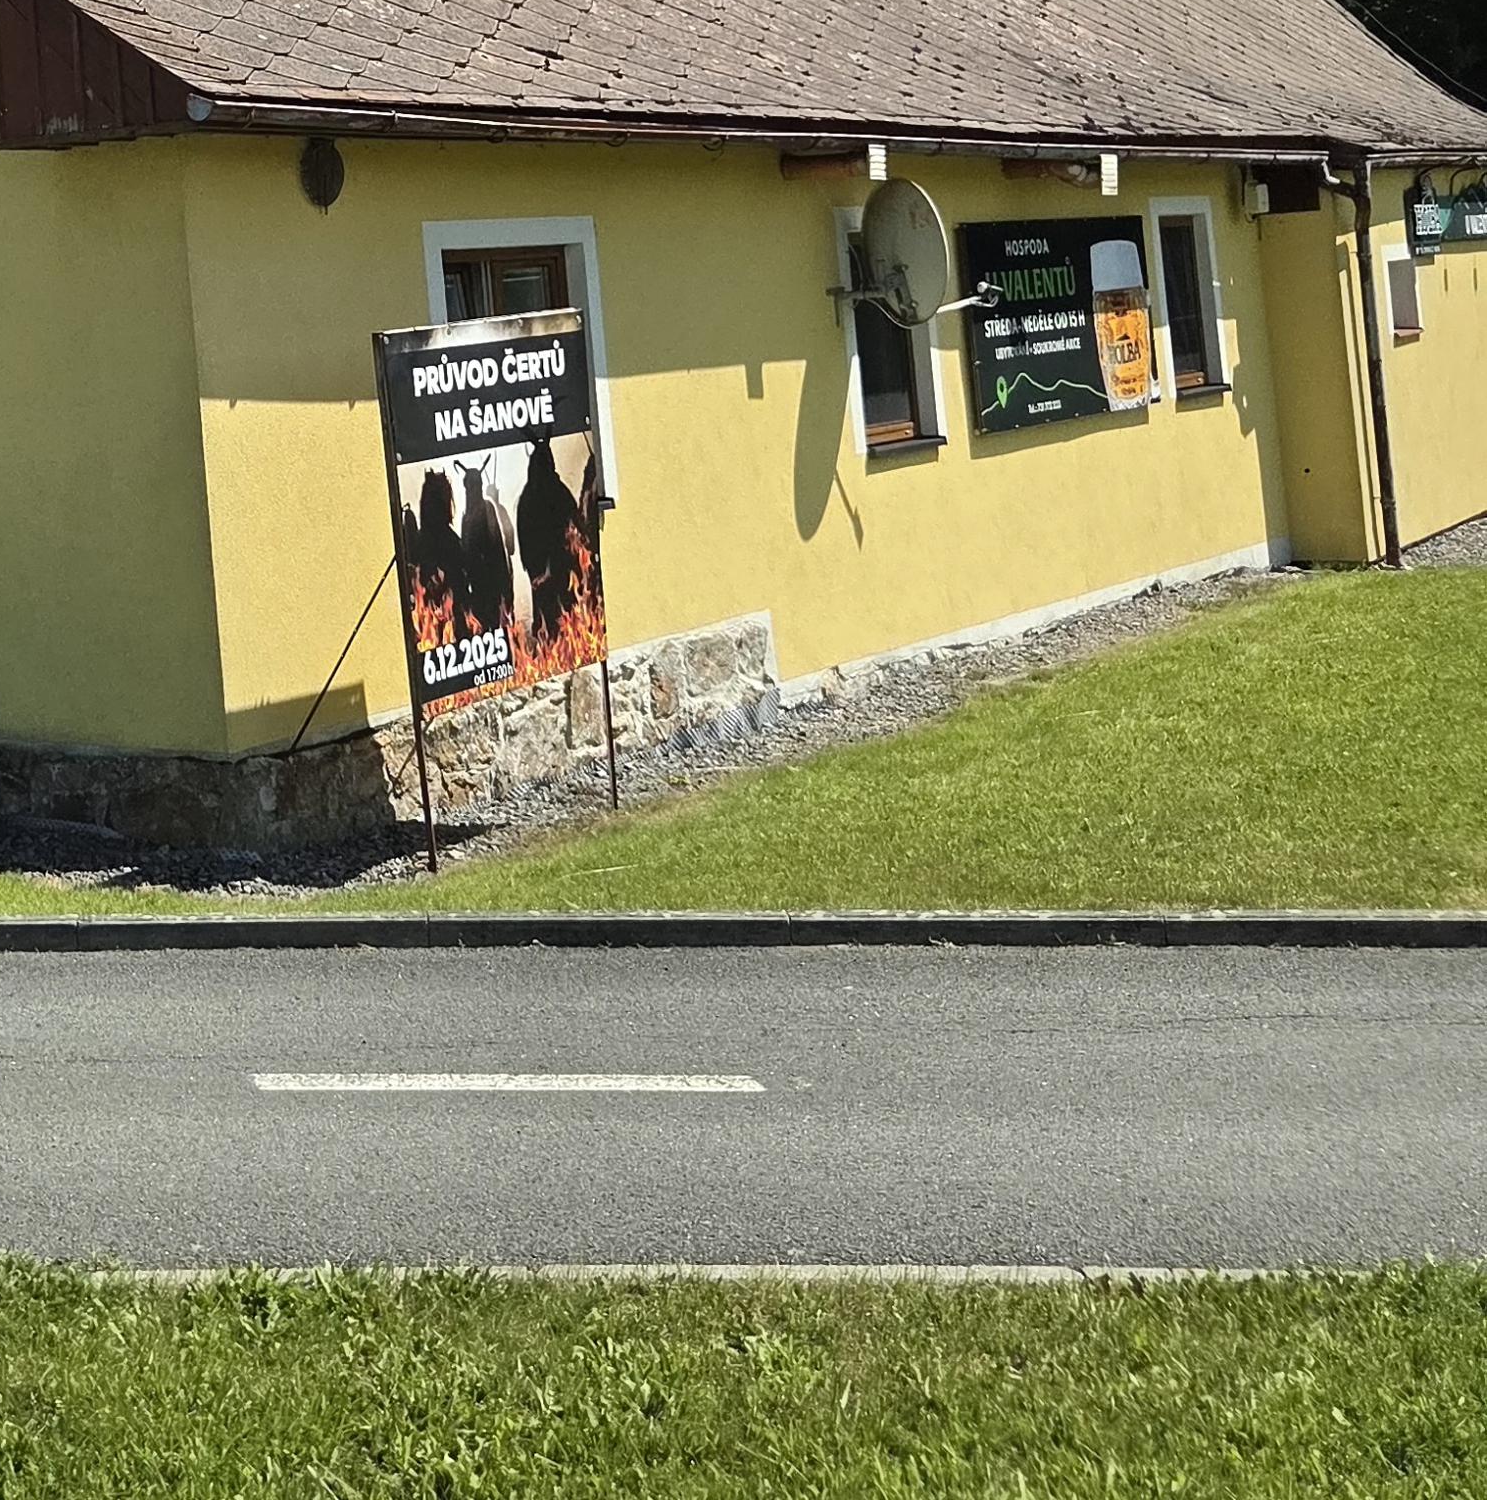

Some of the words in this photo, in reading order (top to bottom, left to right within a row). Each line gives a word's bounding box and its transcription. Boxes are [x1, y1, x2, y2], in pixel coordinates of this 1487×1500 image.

[1005, 237, 1050, 257] HOSPODA
[1000, 256, 1076, 302] VALENTŮ
[983, 313, 1019, 338] STŘEDA
[1021, 308, 1055, 333] NEDĚLE
[1054, 312, 1068, 330] OD
[1077, 308, 1086, 326] H
[413, 354, 499, 397] PRŮVOD
[501, 339, 565, 384] ČERTŮ
[434, 408, 468, 441] NA
[468, 388, 555, 435] ŠANOVĚ
[423, 627, 508, 685] 6.12.2025
[473, 669, 485, 686] od
[487, 664, 508, 681] 17:00
[508, 662, 514, 675] h
